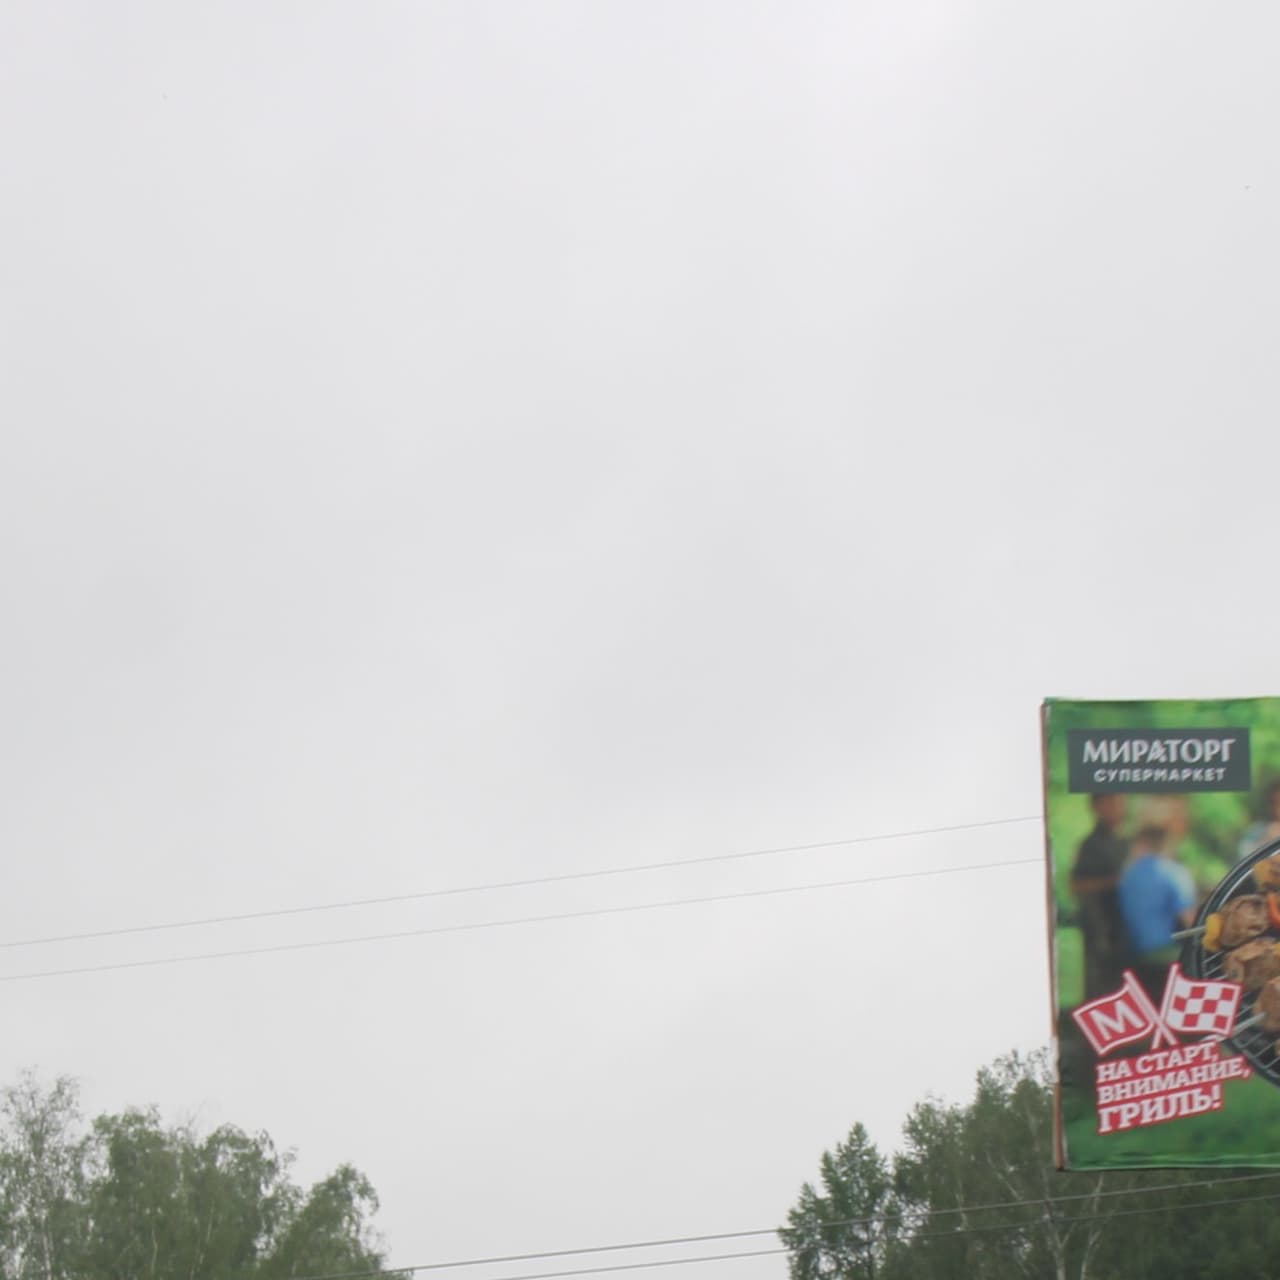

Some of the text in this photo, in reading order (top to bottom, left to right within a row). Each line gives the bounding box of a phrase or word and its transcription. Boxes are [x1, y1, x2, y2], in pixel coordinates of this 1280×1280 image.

[1083, 738, 1237, 764] МИРАТОРГ
[1093, 767, 1227, 783] СУПЕРМАРКЕТ
[1096, 1041, 1219, 1083] НА СТАРТ,
[1096, 1056, 1251, 1105] ВНИМАНИЕ,
[1097, 1084, 1223, 1133] ГРИЛЬ!
